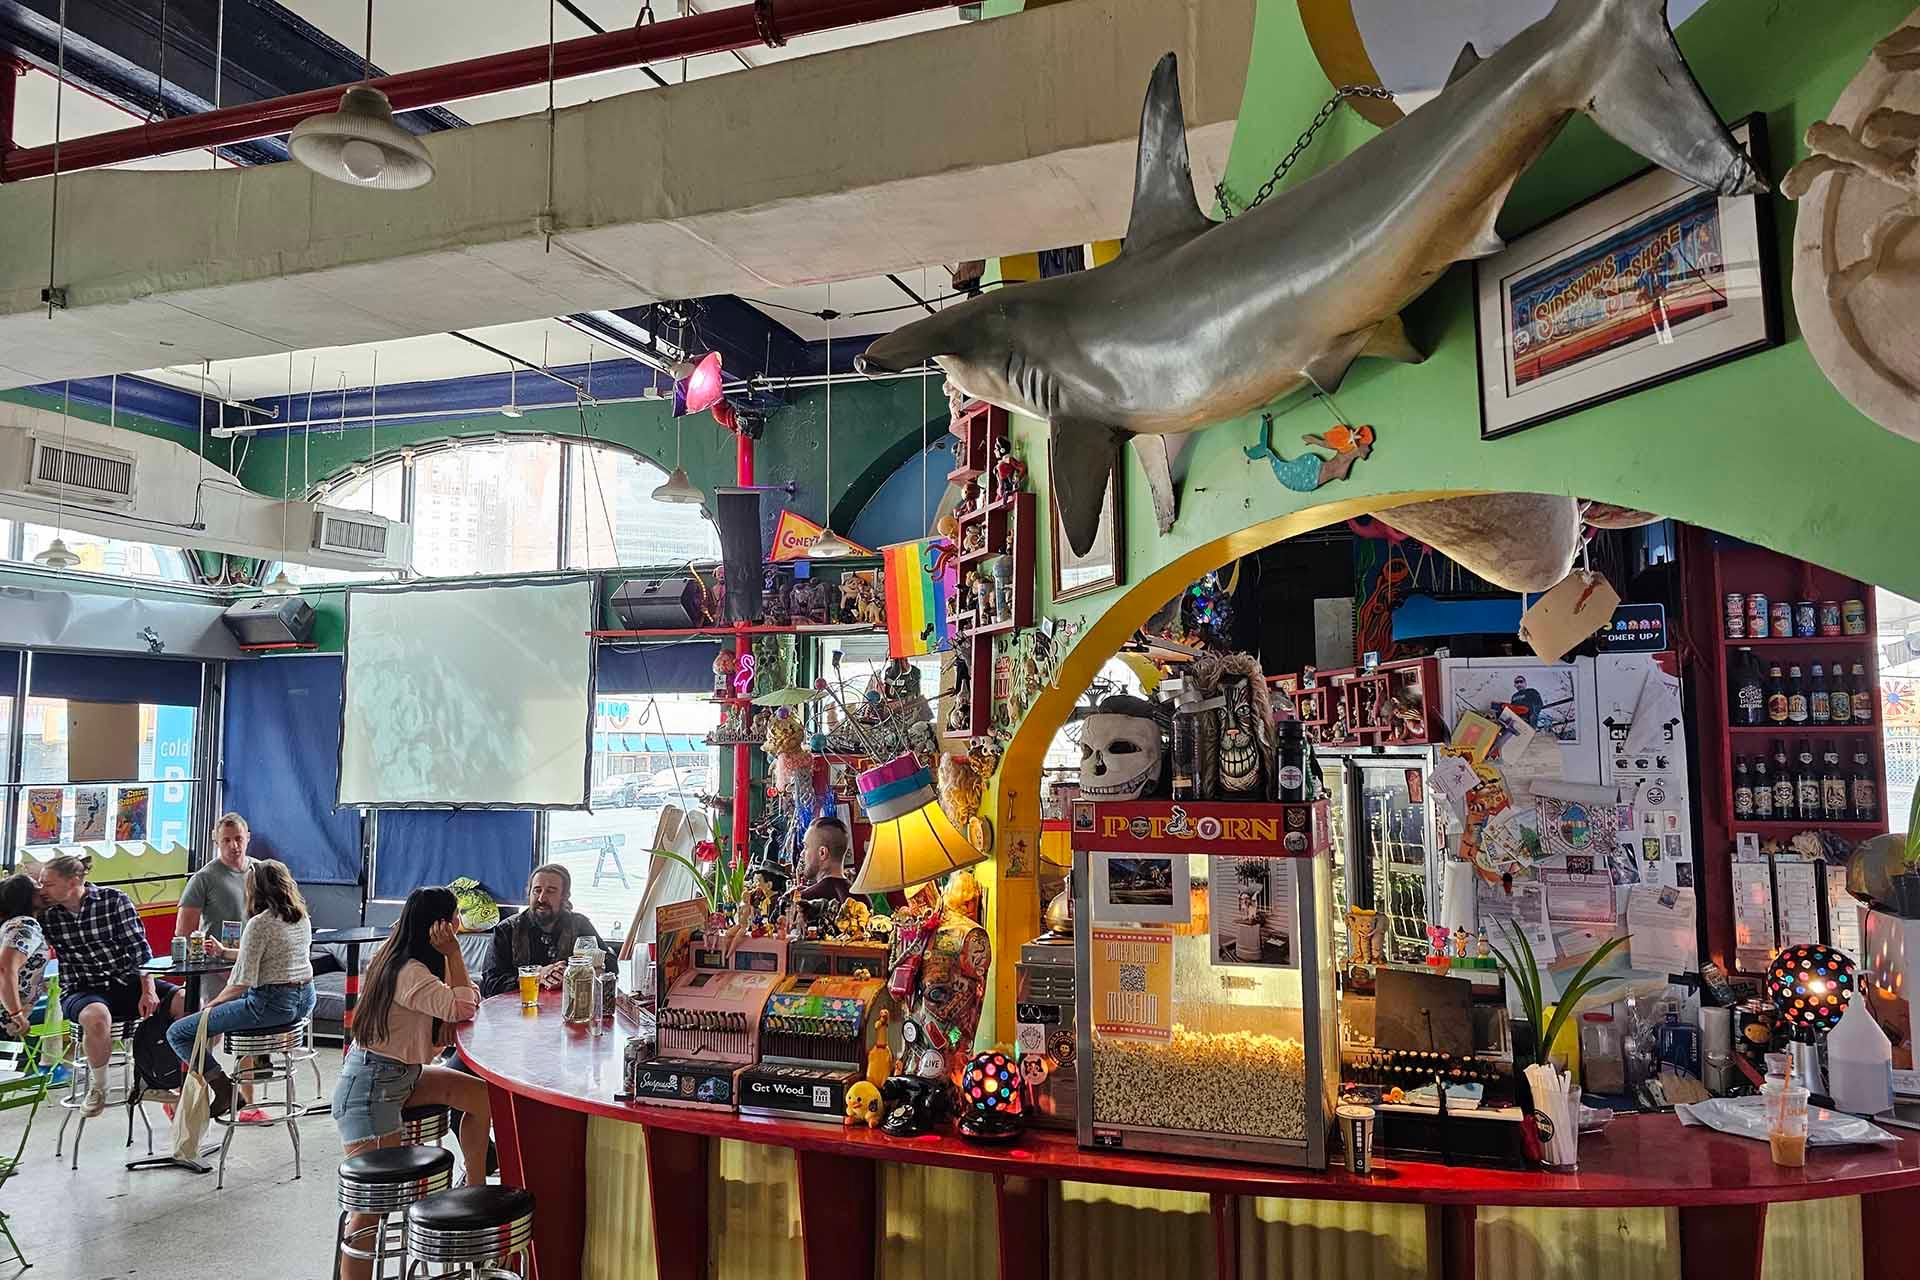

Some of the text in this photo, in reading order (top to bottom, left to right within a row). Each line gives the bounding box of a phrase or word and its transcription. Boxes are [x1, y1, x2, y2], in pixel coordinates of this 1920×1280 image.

[1534, 255, 1616, 339] SIDESHOWS
[1601, 632, 1660, 641] OWER UP!
[160, 737, 189, 757] cold
[1107, 991, 1158, 1024] MUSEUM
[751, 1083, 804, 1095] Get Wood
